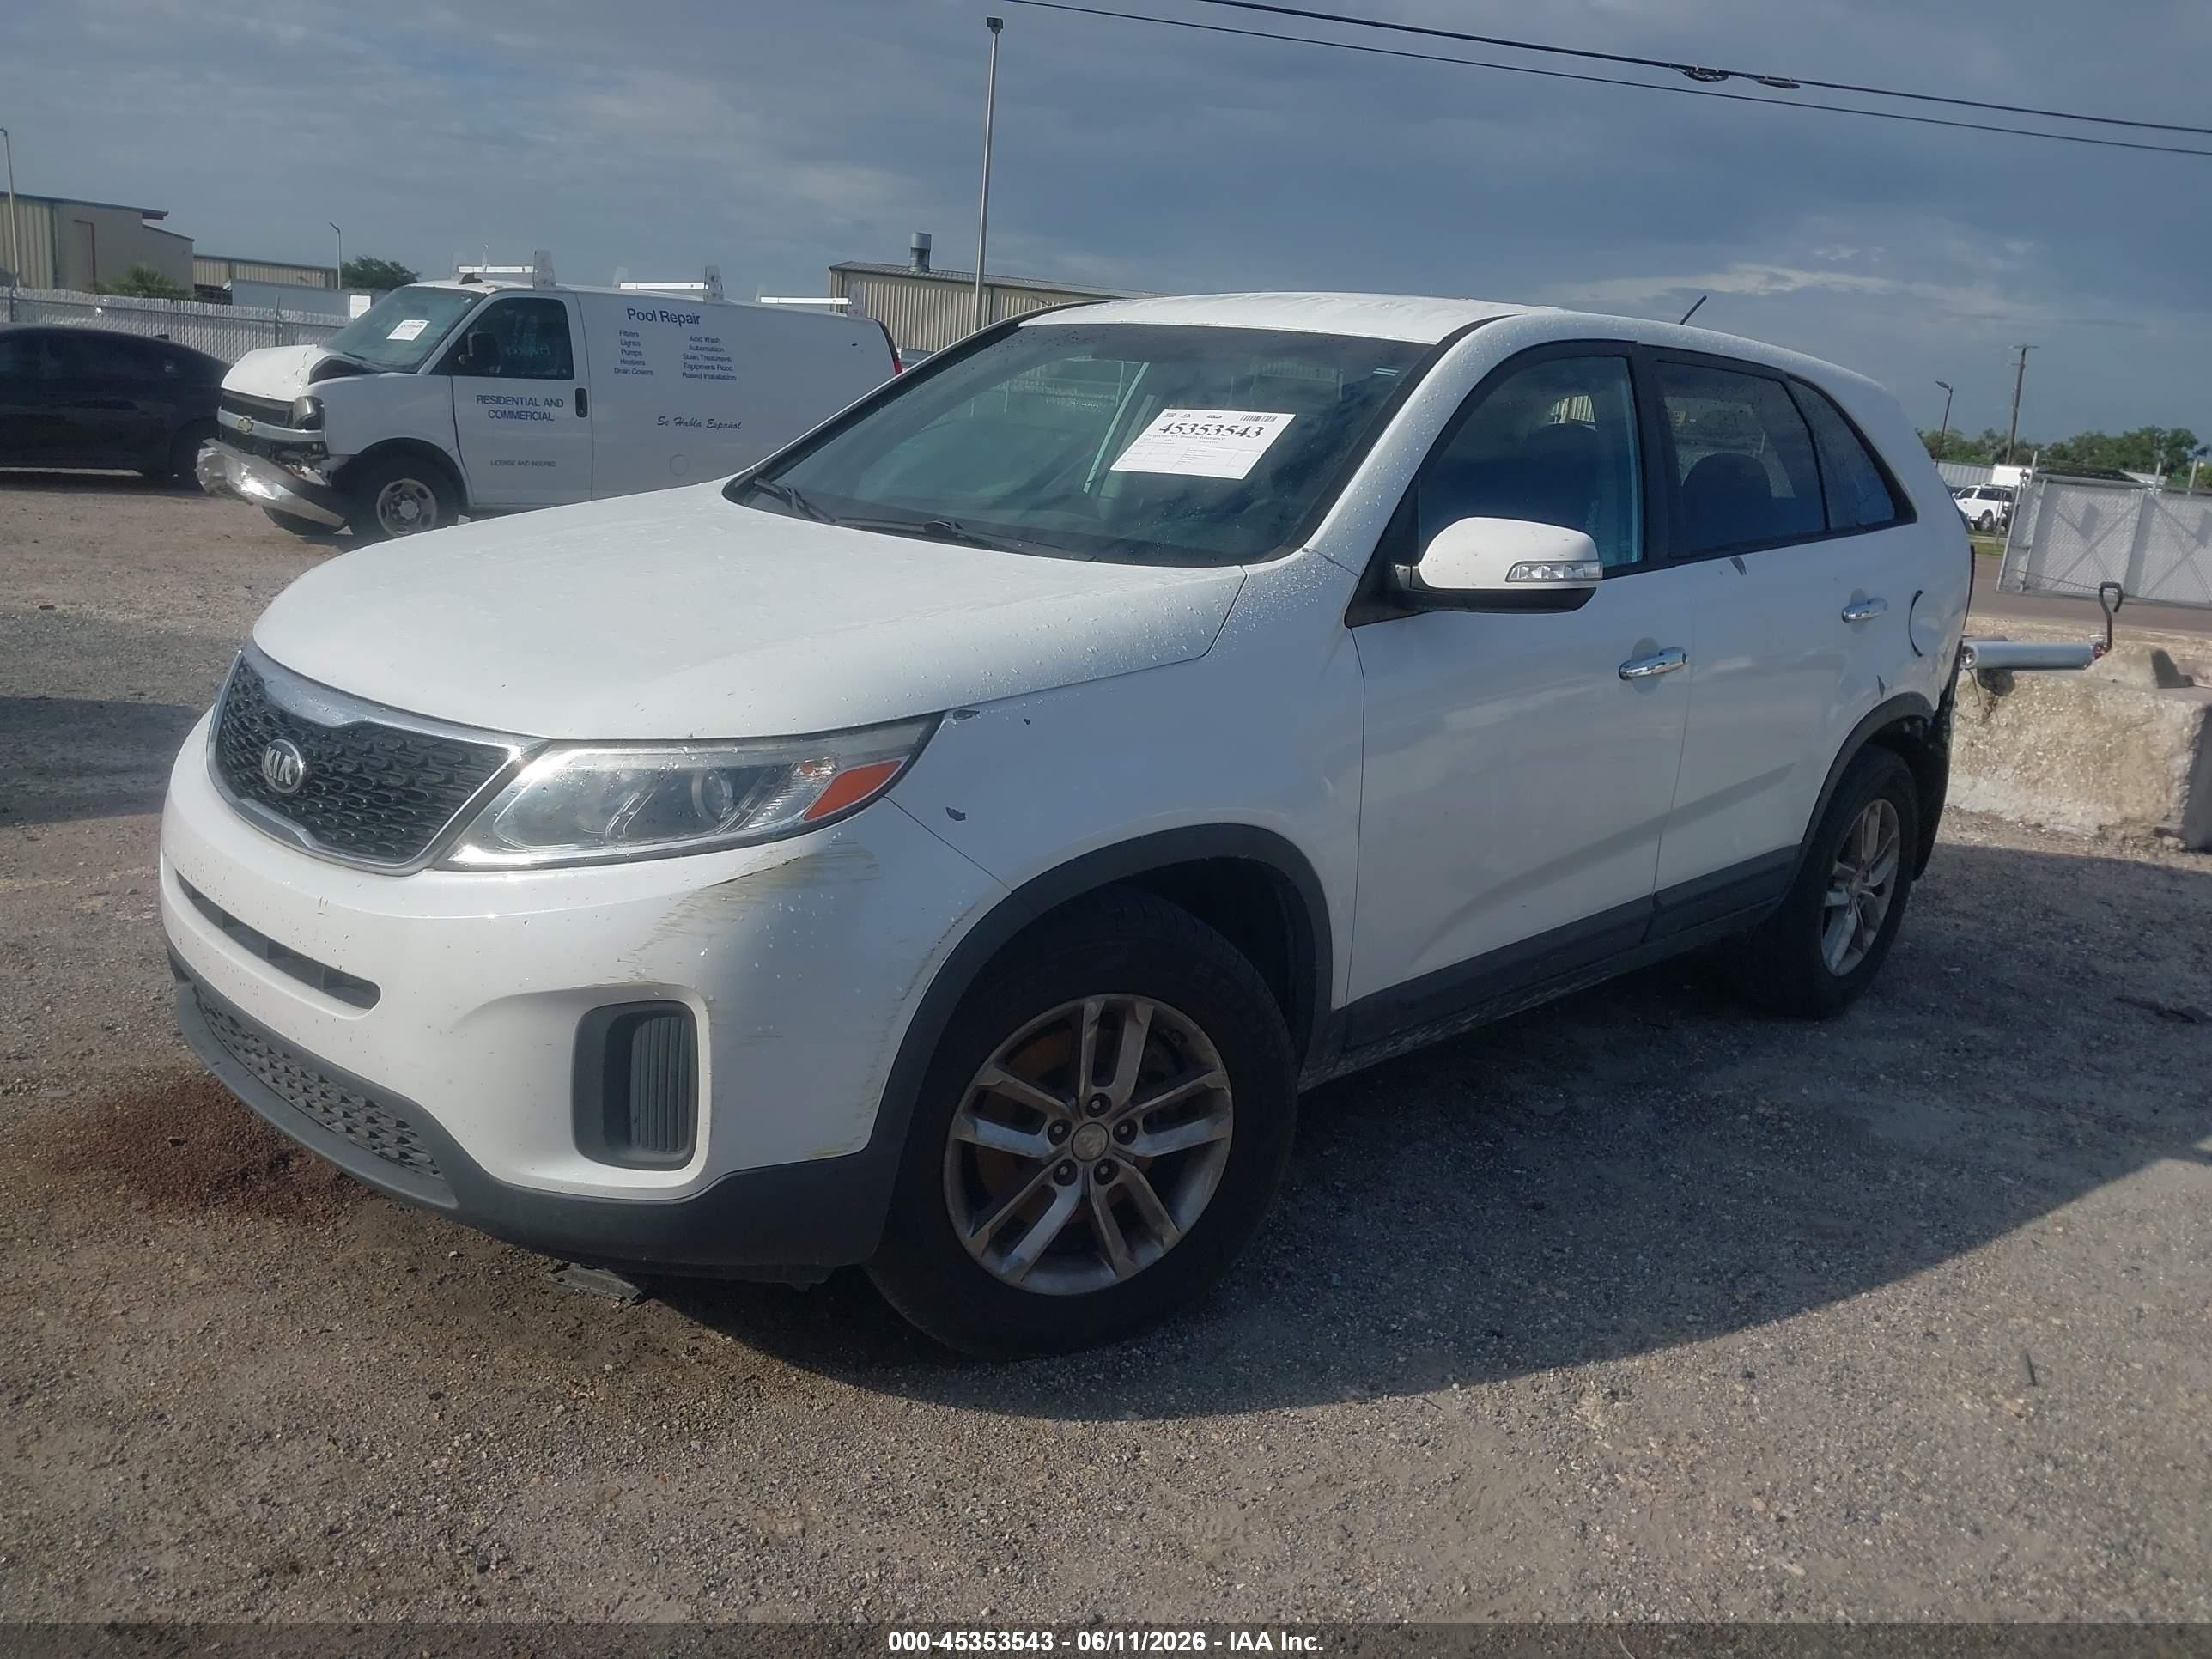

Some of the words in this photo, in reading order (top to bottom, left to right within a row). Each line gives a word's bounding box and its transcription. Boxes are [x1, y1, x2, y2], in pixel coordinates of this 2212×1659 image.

[627, 307, 658, 322] Pool
[659, 310, 701, 327] Repair
[621, 349, 642, 357] Pumps
[476, 394, 541, 407] RESIDENTIAL
[543, 398, 564, 408] AND
[488, 409, 556, 422] COMMERCIAL
[657, 416, 670, 427] Se
[673, 416, 702, 428] Habla
[706, 418, 742, 430] Español
[1158, 422, 1265, 439] 45353543
[264, 745, 292, 786] KIA
